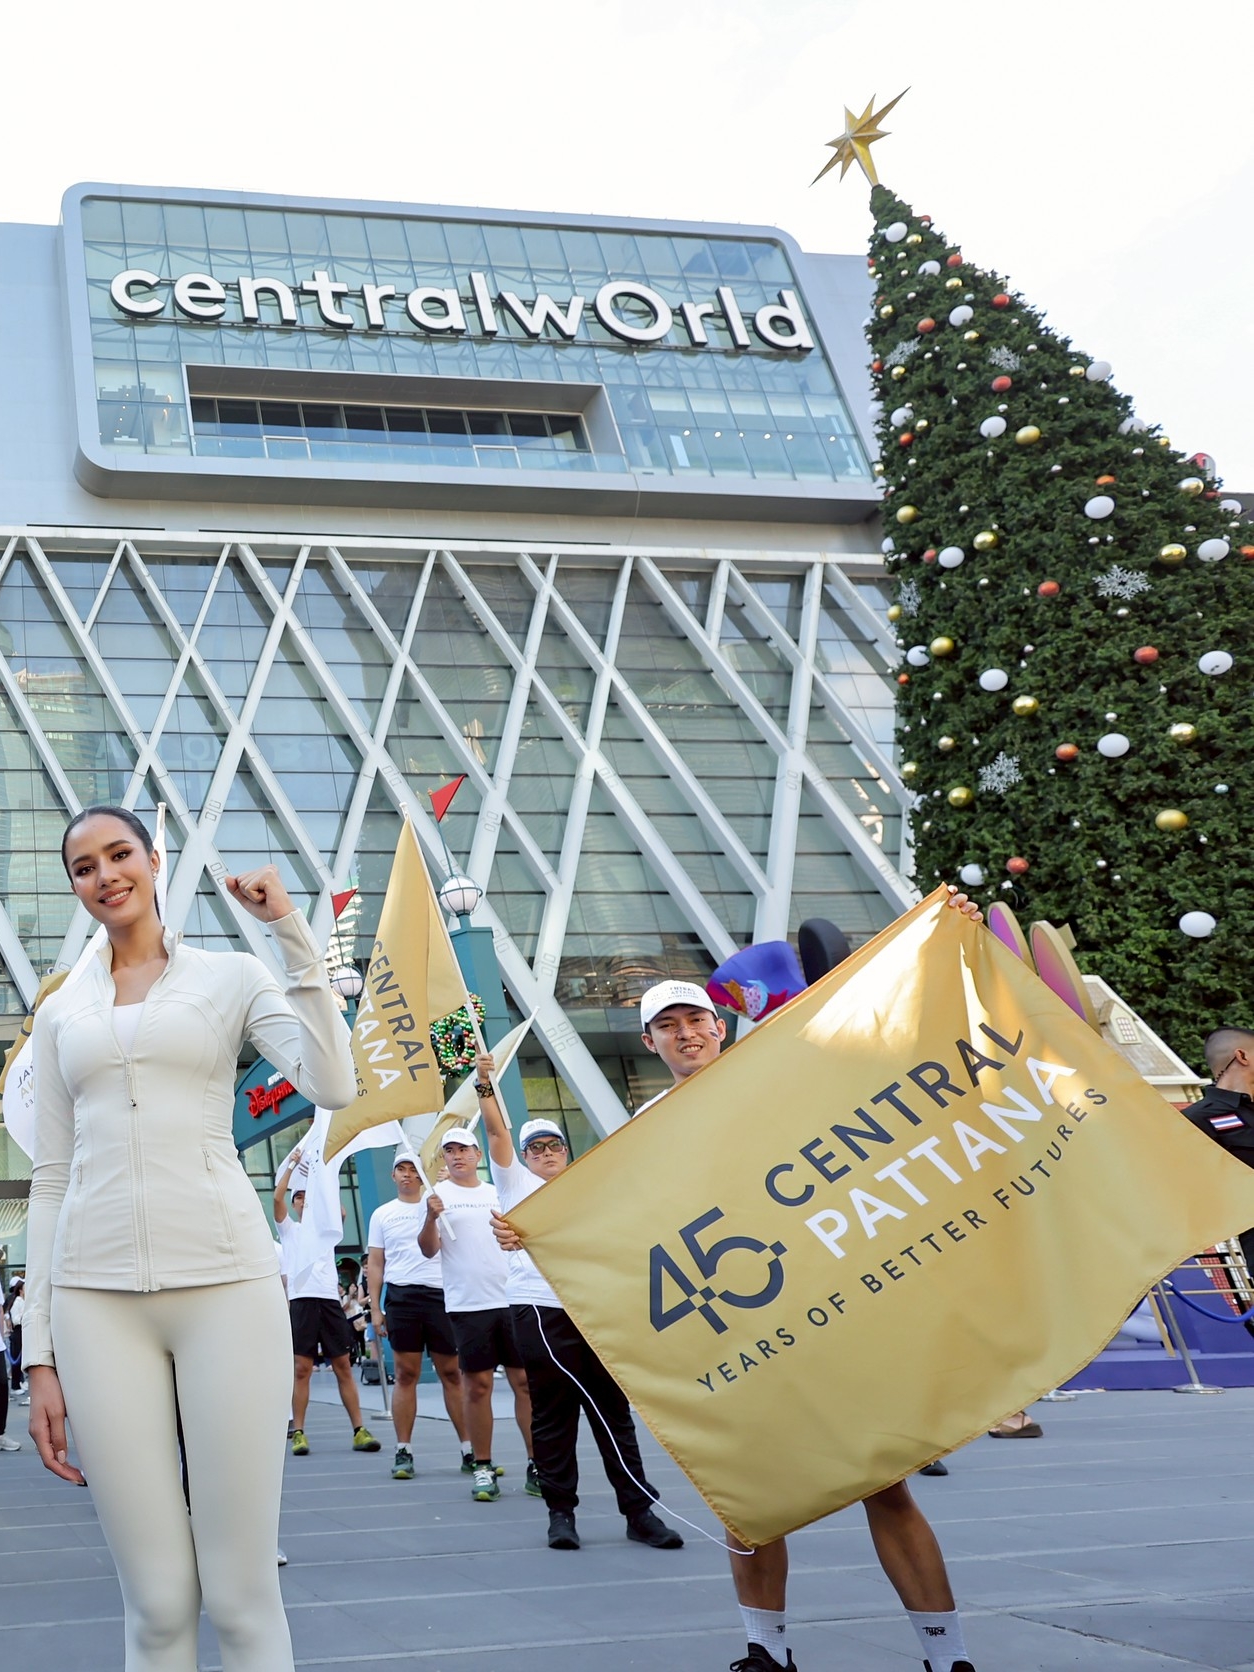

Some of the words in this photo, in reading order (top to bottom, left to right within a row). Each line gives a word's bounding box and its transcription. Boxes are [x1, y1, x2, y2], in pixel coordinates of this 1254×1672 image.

[764, 1022, 1025, 1207] CENTRAL
[804, 1056, 1077, 1260] PATTANA
[649, 1206, 788, 1335] 45
[697, 1326, 796, 1393] YEARS
[807, 1292, 847, 1327] OF
[860, 1208, 987, 1294] BETTER
[992, 1087, 1109, 1210] FUTURES
